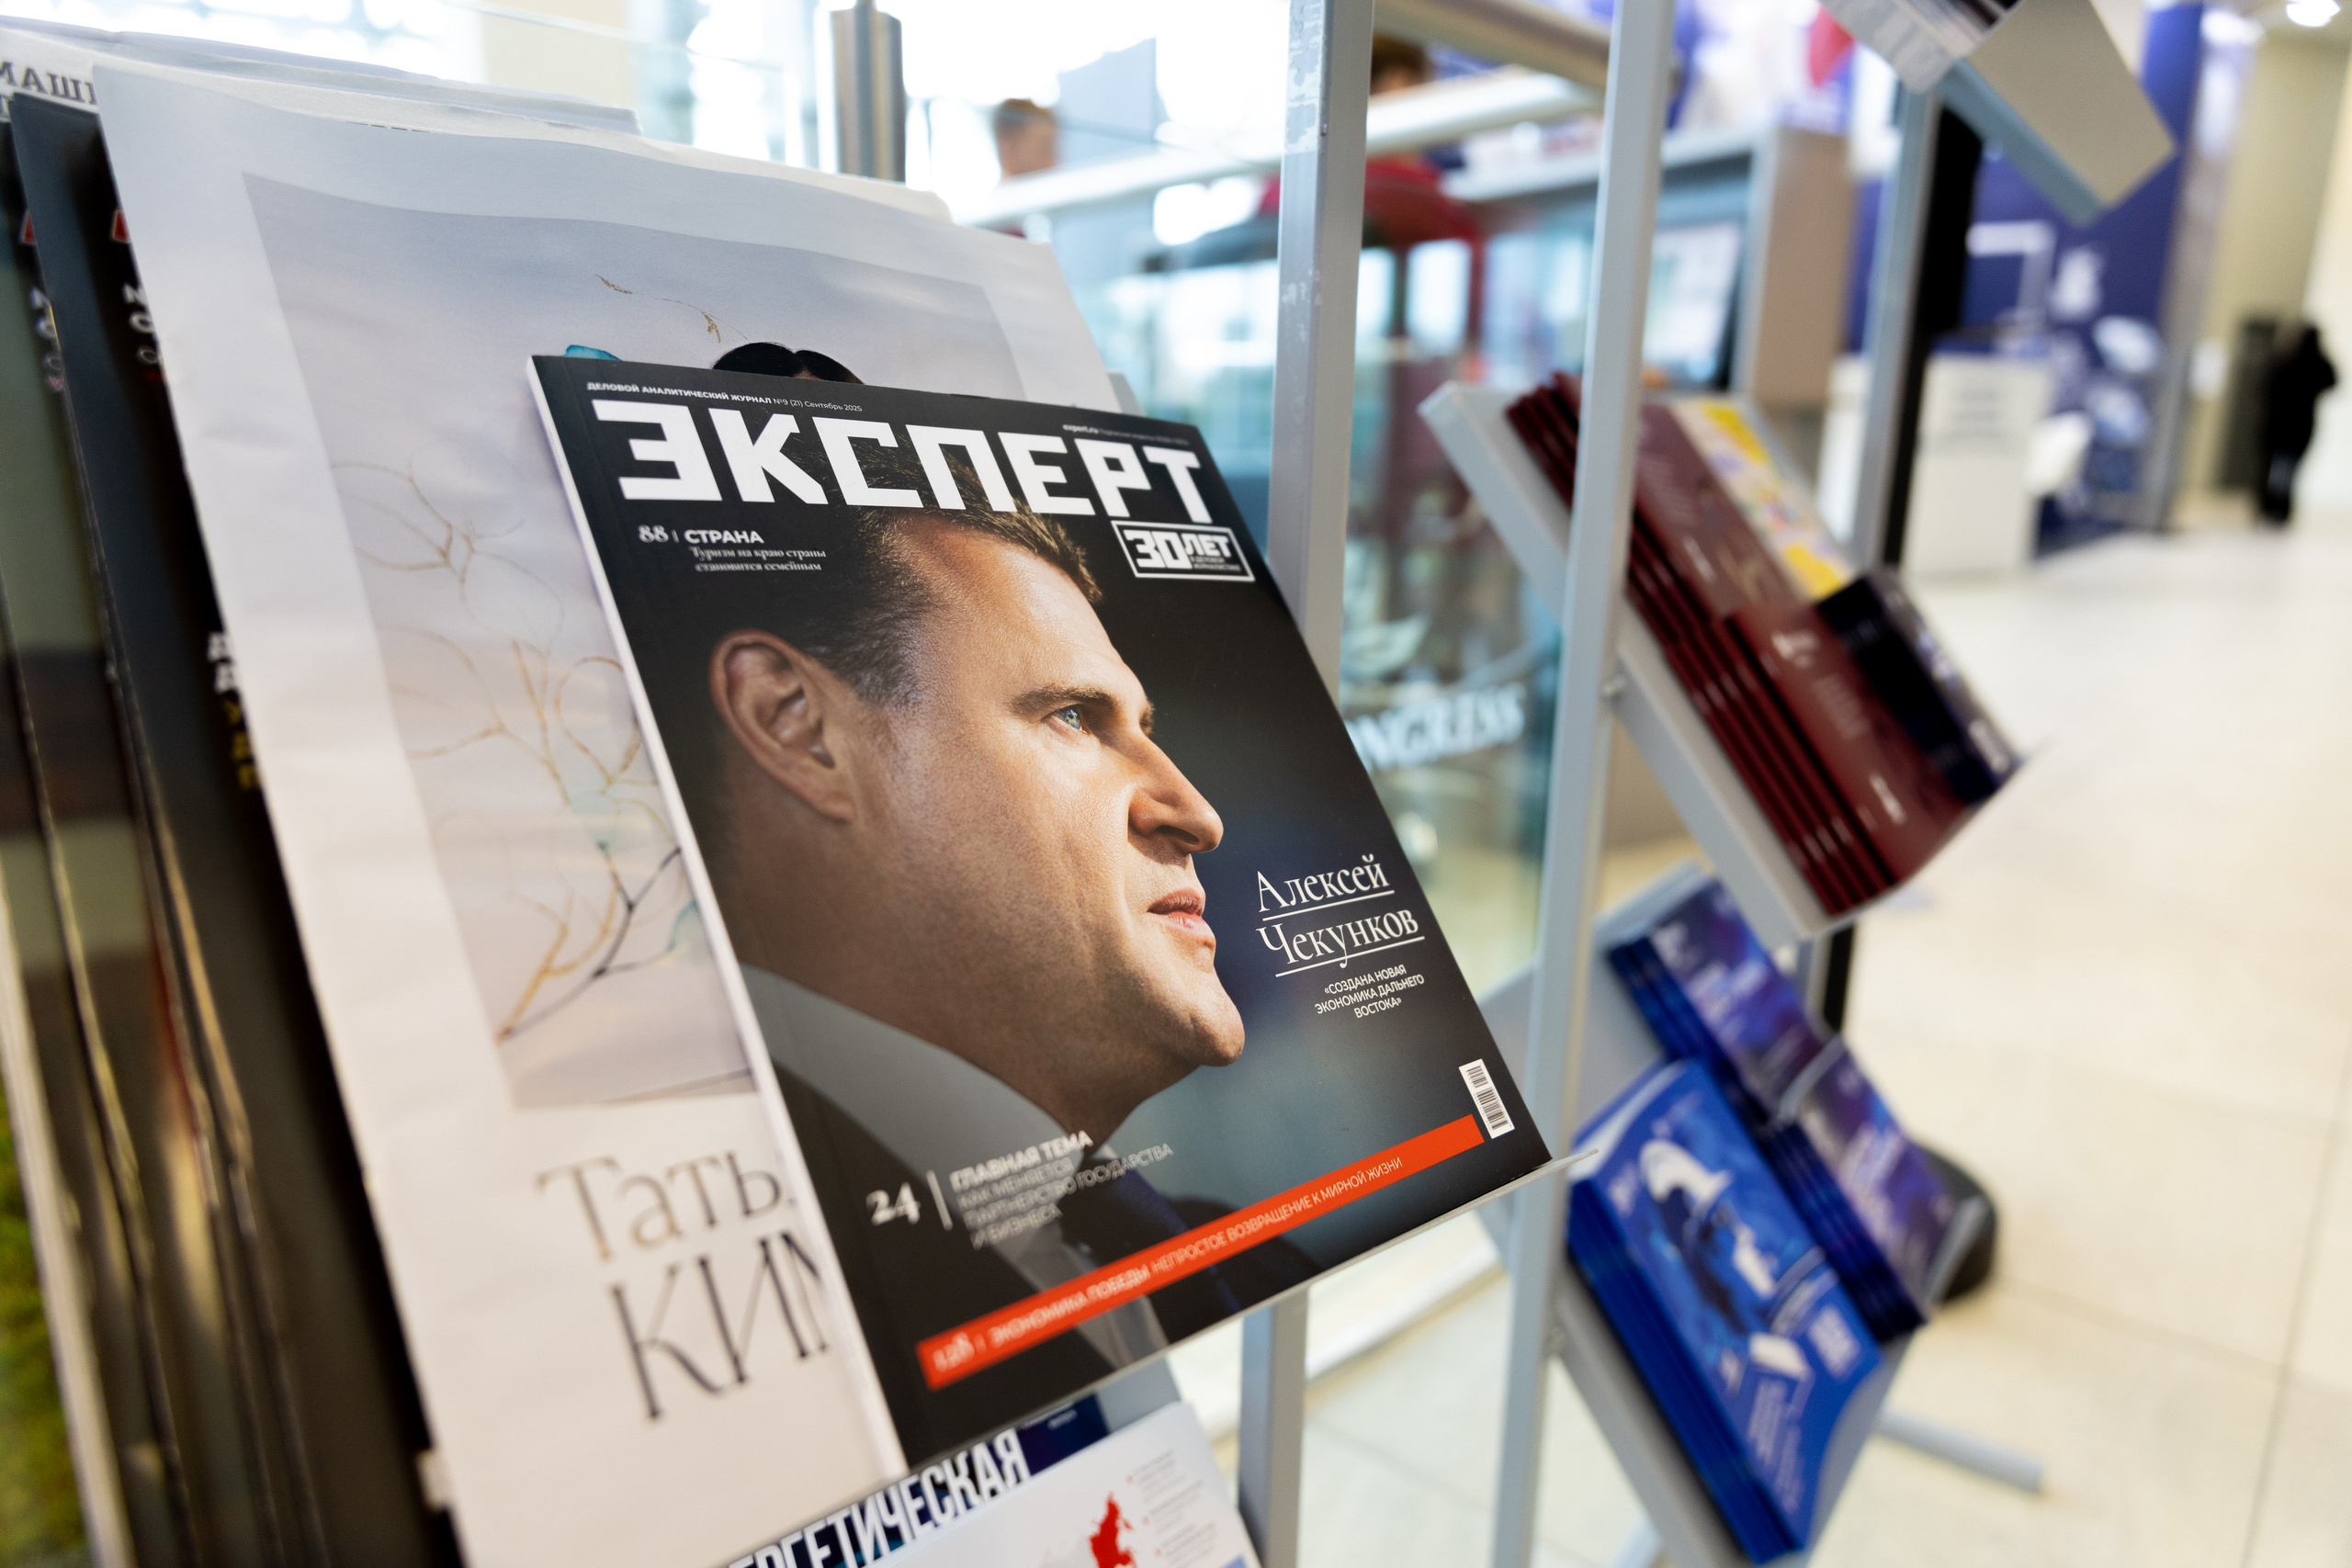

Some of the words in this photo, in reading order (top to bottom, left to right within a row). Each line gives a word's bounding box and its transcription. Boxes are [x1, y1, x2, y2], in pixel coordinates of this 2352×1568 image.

[587, 381, 640, 393] ДЕЛОВОЙ
[642, 385, 729, 401] АНАЛИТИЧЕСКИЙ
[730, 393, 772, 404] ЖУРНАЛ
[789, 399, 804, 408] (21)
[804, 400, 843, 412] Сентябрь
[843, 404, 863, 412] 2025
[1062, 424, 1099, 434] expert.ru
[591, 399, 1213, 525] ЭКСПЕРТ
[638, 525, 670, 543] 88
[684, 529, 765, 544] СТРАНА
[690, 546, 735, 561] Туризм
[737, 549, 752, 558] на
[754, 549, 785, 560] краю
[786, 549, 827, 560] страны
[1123, 529, 1193, 569] 30
[1181, 533, 1232, 558] ЛЕТ
[695, 561, 763, 572] становится
[764, 561, 822, 571] семейным
[1257, 853, 1390, 913] Алексей
[1255, 909, 1419, 968] Чекунков
[1315, 987, 1378, 1014] ЭКОНОМИКА
[1378, 974, 1425, 997] ДАЛЬНЕГО
[1324, 973, 1374, 995] «СОЗДАНА
[1376, 964, 1408, 982] НОВАЯ
[1353, 997, 1402, 1019] ВОСТОКА»
[950, 1145, 1042, 1192] ГЛАВНАЯ
[1039, 1130, 1094, 1162] ТЕМА
[1076, 1143, 1175, 1190] ГОСУДАРСТВА
[531, 1147, 797, 1261] Тать
[865, 1181, 921, 1226] 24
[987, 1290, 1090, 1348] ЭКОНОМИКА
[1085, 1263, 1151, 1303] ПОБЕДЫ
[1149, 1232, 1229, 1275] НЕПРОСТОЕ
[1226, 1195, 1314, 1243] ВОЗВРАЩЕНИЕ
[1311, 1192, 1322, 1206] К
[1319, 1169, 1367, 1201] МИРНОЙ
[1366, 1156, 1403, 1181] ЖИЗНИ
[725, 1427, 1032, 1568] ГЕТИЧЕСКАЯ
